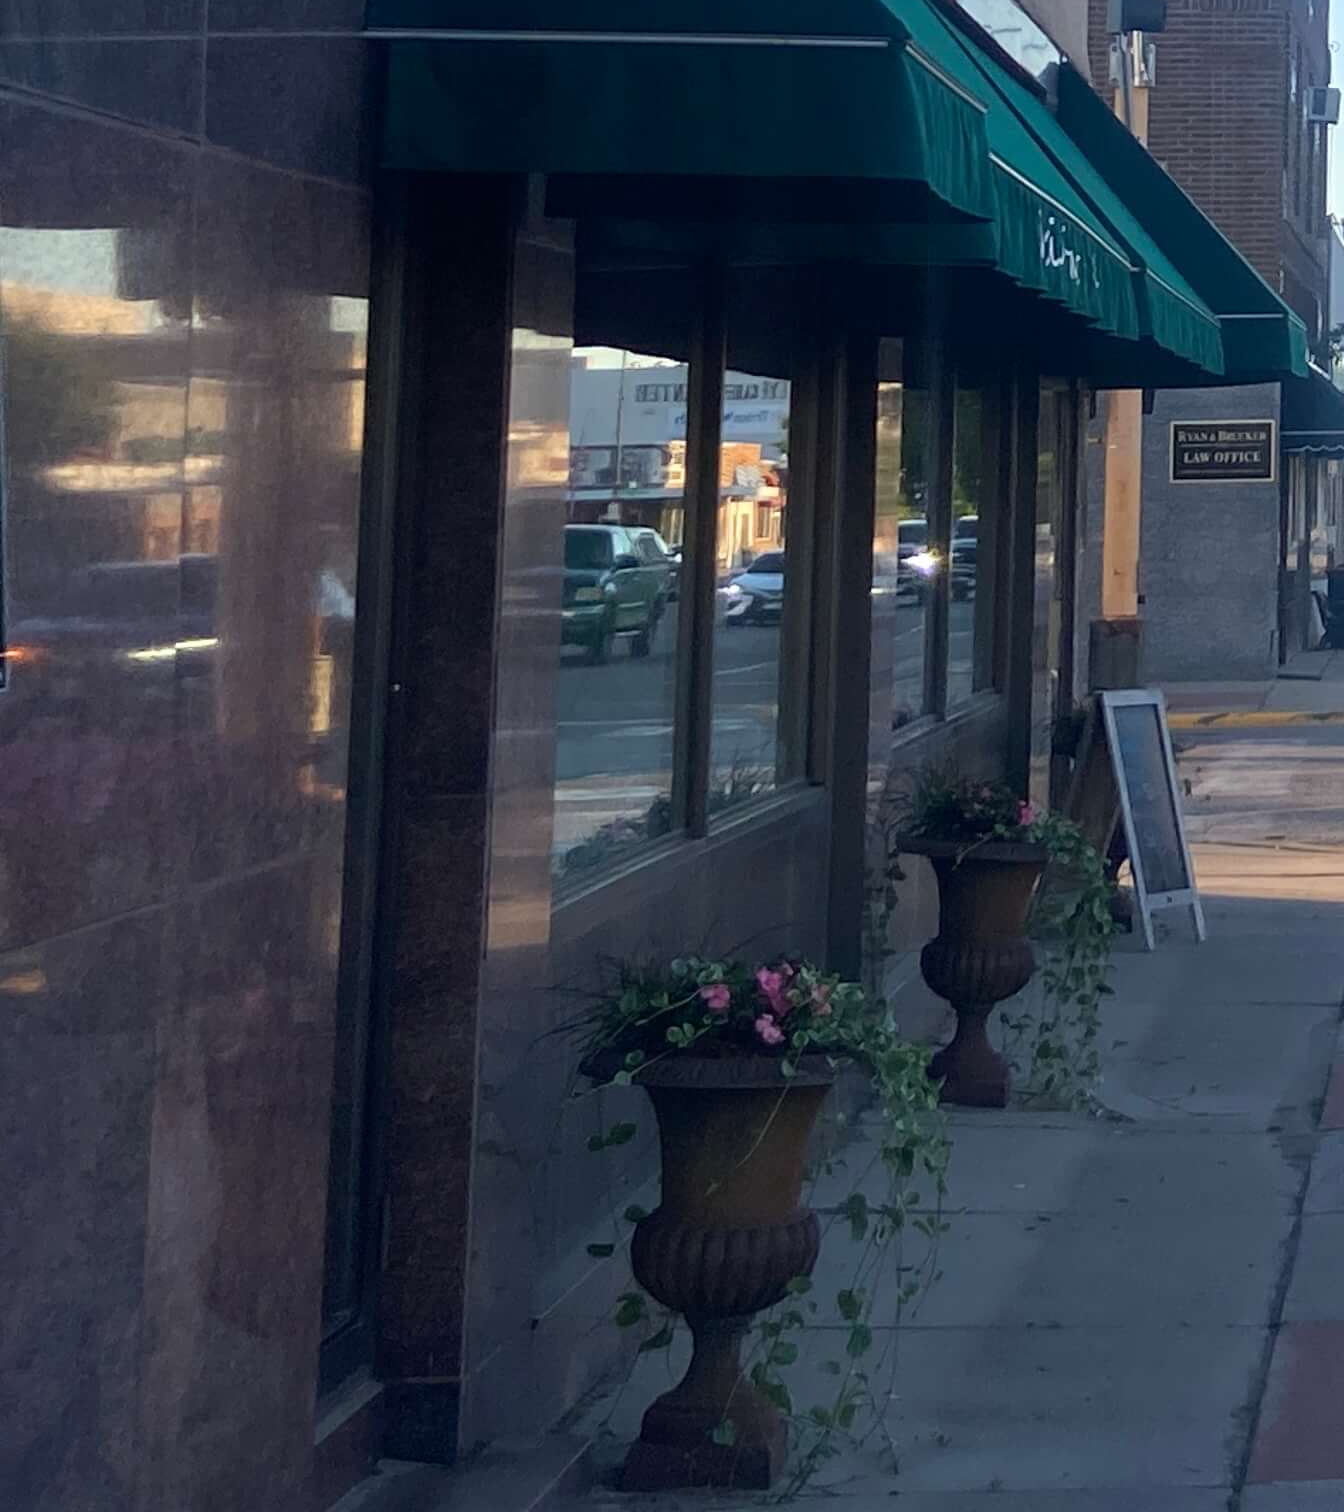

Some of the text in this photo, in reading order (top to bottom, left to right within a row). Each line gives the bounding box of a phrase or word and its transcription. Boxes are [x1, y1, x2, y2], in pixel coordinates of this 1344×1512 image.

[1177, 431, 1208, 443] RYAN
[1183, 450, 1261, 465] LAW OFFICE
